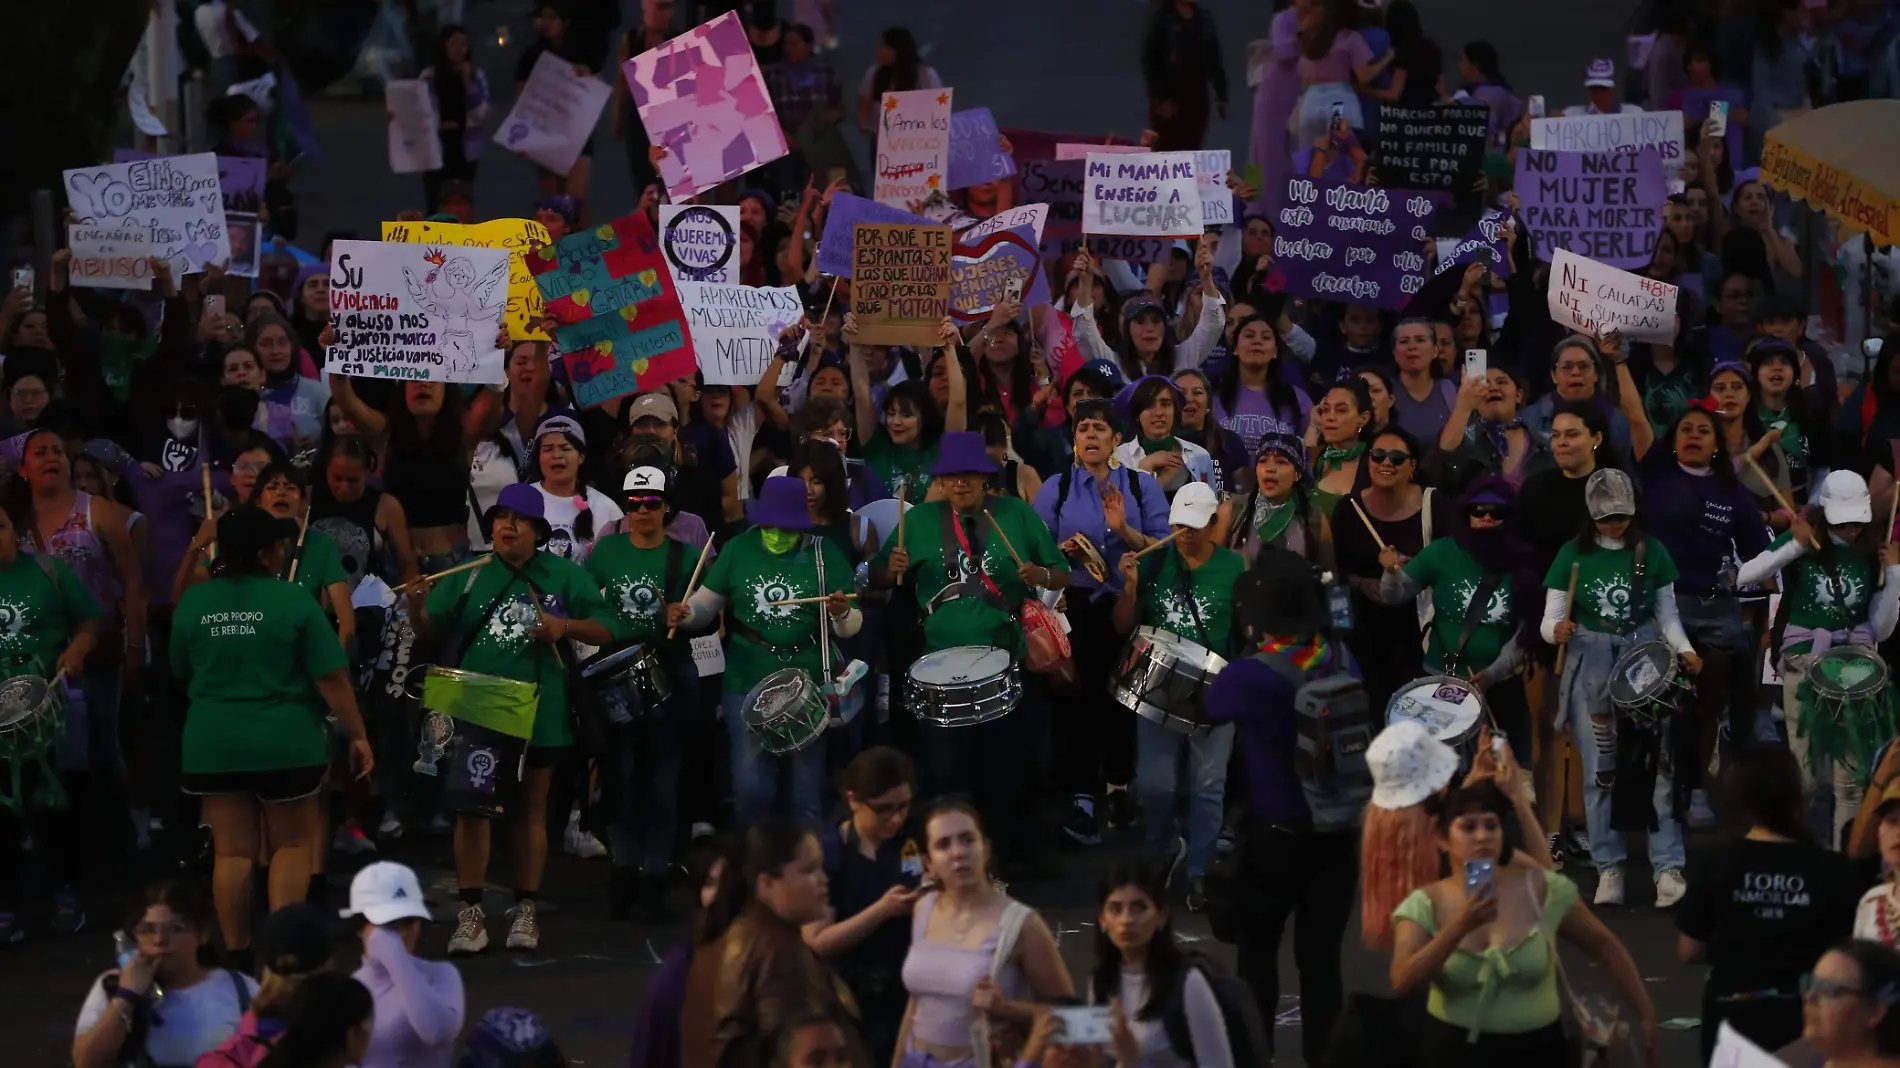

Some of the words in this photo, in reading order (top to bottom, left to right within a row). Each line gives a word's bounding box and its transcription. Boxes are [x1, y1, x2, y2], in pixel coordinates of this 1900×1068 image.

[1380, 105, 1437, 120] MARCHO
[1380, 122, 1397, 134] NO
[1404, 125, 1452, 136] QUIERO
[1458, 125, 1487, 138] QUE
[1545, 119, 1622, 150] MARCHO
[1633, 117, 1671, 143] HOY
[1381, 140, 1398, 150] MI
[1405, 141, 1468, 156] FAMILIA
[1118, 160, 1169, 181] MAMÁ
[1173, 162, 1193, 179] ME
[1383, 155, 1420, 169] PASE
[1429, 157, 1460, 173] POR
[1525, 151, 1557, 173] NO
[1582, 152, 1639, 174] NACI
[1409, 172, 1452, 185] ESTO
[1095, 184, 1157, 203] ENSEÑÓ
[1169, 189, 1180, 203] A
[1539, 176, 1638, 205] MUJER
[685, 211, 713, 225] NOS
[1010, 209, 1038, 226] LAS
[1100, 202, 1192, 230] LUCHAR
[1526, 206, 1580, 228] PARA
[1588, 208, 1656, 228] MORIR
[665, 227, 736, 245] QUEREMOS
[856, 228, 883, 246] POR
[888, 228, 919, 246] QUÉ
[923, 231, 946, 246] TE
[1531, 229, 1573, 251] POR
[1578, 230, 1657, 258] SERLO
[678, 247, 718, 264] VIVAS
[1275, 236, 1333, 260] luchar
[1346, 246, 1376, 267] por
[1393, 251, 1424, 272] mis
[71, 256, 149, 278] ABUSO
[331, 254, 363, 289] Su
[678, 268, 727, 282] LIBRES
[884, 268, 910, 282] QUE
[911, 266, 949, 282] LUCHAN
[951, 254, 1018, 280] UJERES
[1312, 272, 1380, 298] derechos
[1401, 275, 1424, 294] 8M
[1563, 263, 1589, 294] NI
[857, 285, 863, 296] Y
[868, 284, 888, 296] NO
[892, 285, 916, 297] POR
[1639, 278, 1677, 299] #8M
[700, 286, 798, 311] APARECEMOS
[857, 301, 881, 315] QUE
[954, 295, 980, 309] QUE
[692, 307, 767, 328] MUERTAS
[1559, 291, 1581, 313] NI
[1591, 303, 1659, 329] SUMISAS
[346, 313, 394, 331] abuso
[399, 313, 429, 330] nos
[1573, 311, 1620, 336] NUNCA
[341, 363, 364, 374] en
[200, 612, 230, 625] AMOR
[211, 627, 219, 637] ES
[1743, 872, 1805, 892] FORO
